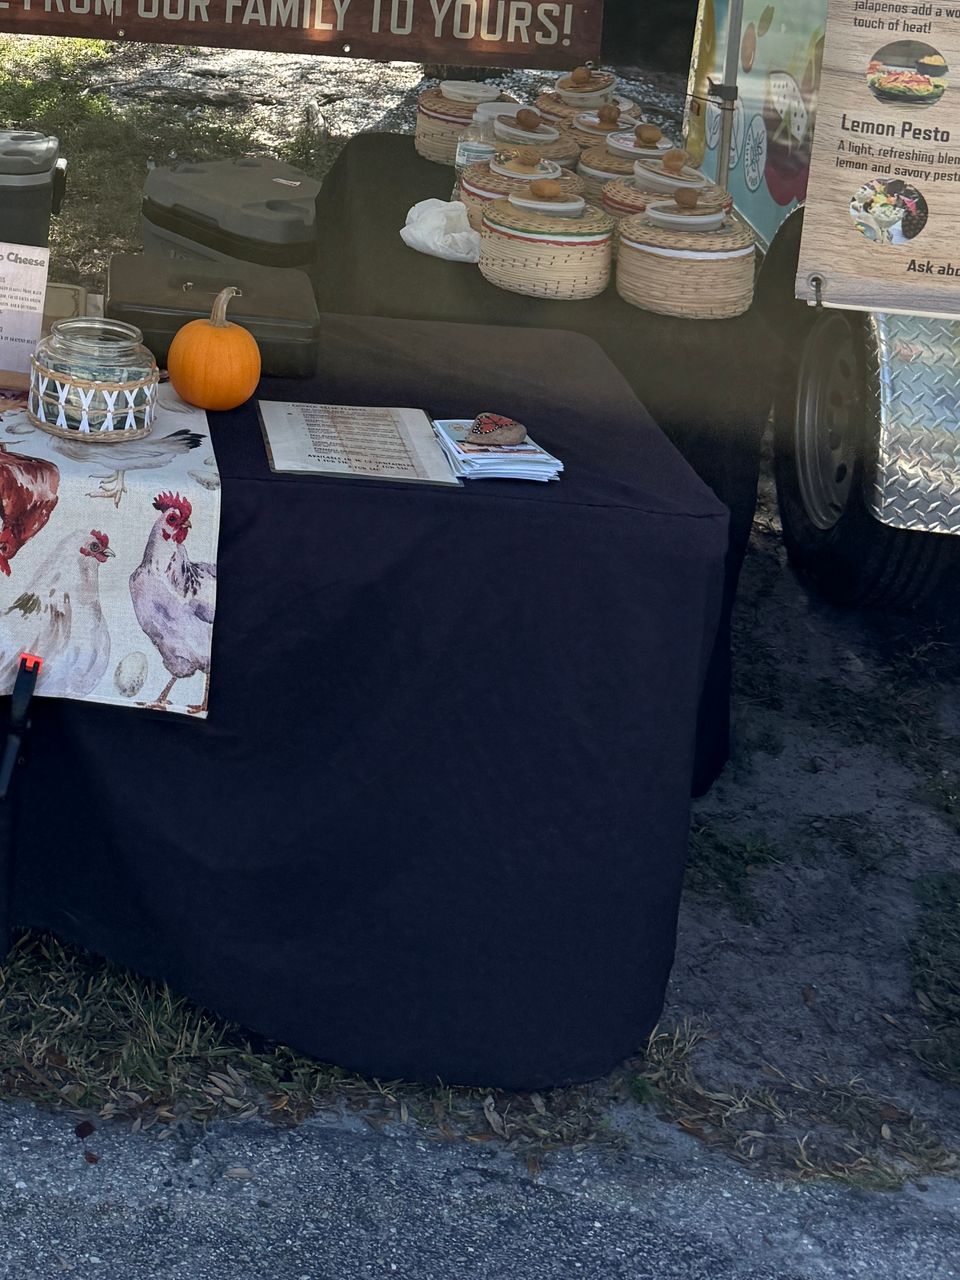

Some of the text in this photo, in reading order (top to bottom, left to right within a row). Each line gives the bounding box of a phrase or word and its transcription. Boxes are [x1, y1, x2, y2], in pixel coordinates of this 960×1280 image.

[911, 3, 932, 16] add
[935, 8, 942, 17] a
[853, 16, 932, 34] touch of heat!
[841, 114, 950, 143] Lemon Pesto
[837, 140, 845, 152] A
[848, 141, 875, 157] light,
[878, 147, 935, 165] refreshing
[836, 157, 960, 183] lemon and savory pest
[6, 251, 46, 267] Cheese
[907, 259, 934, 274] Ask
